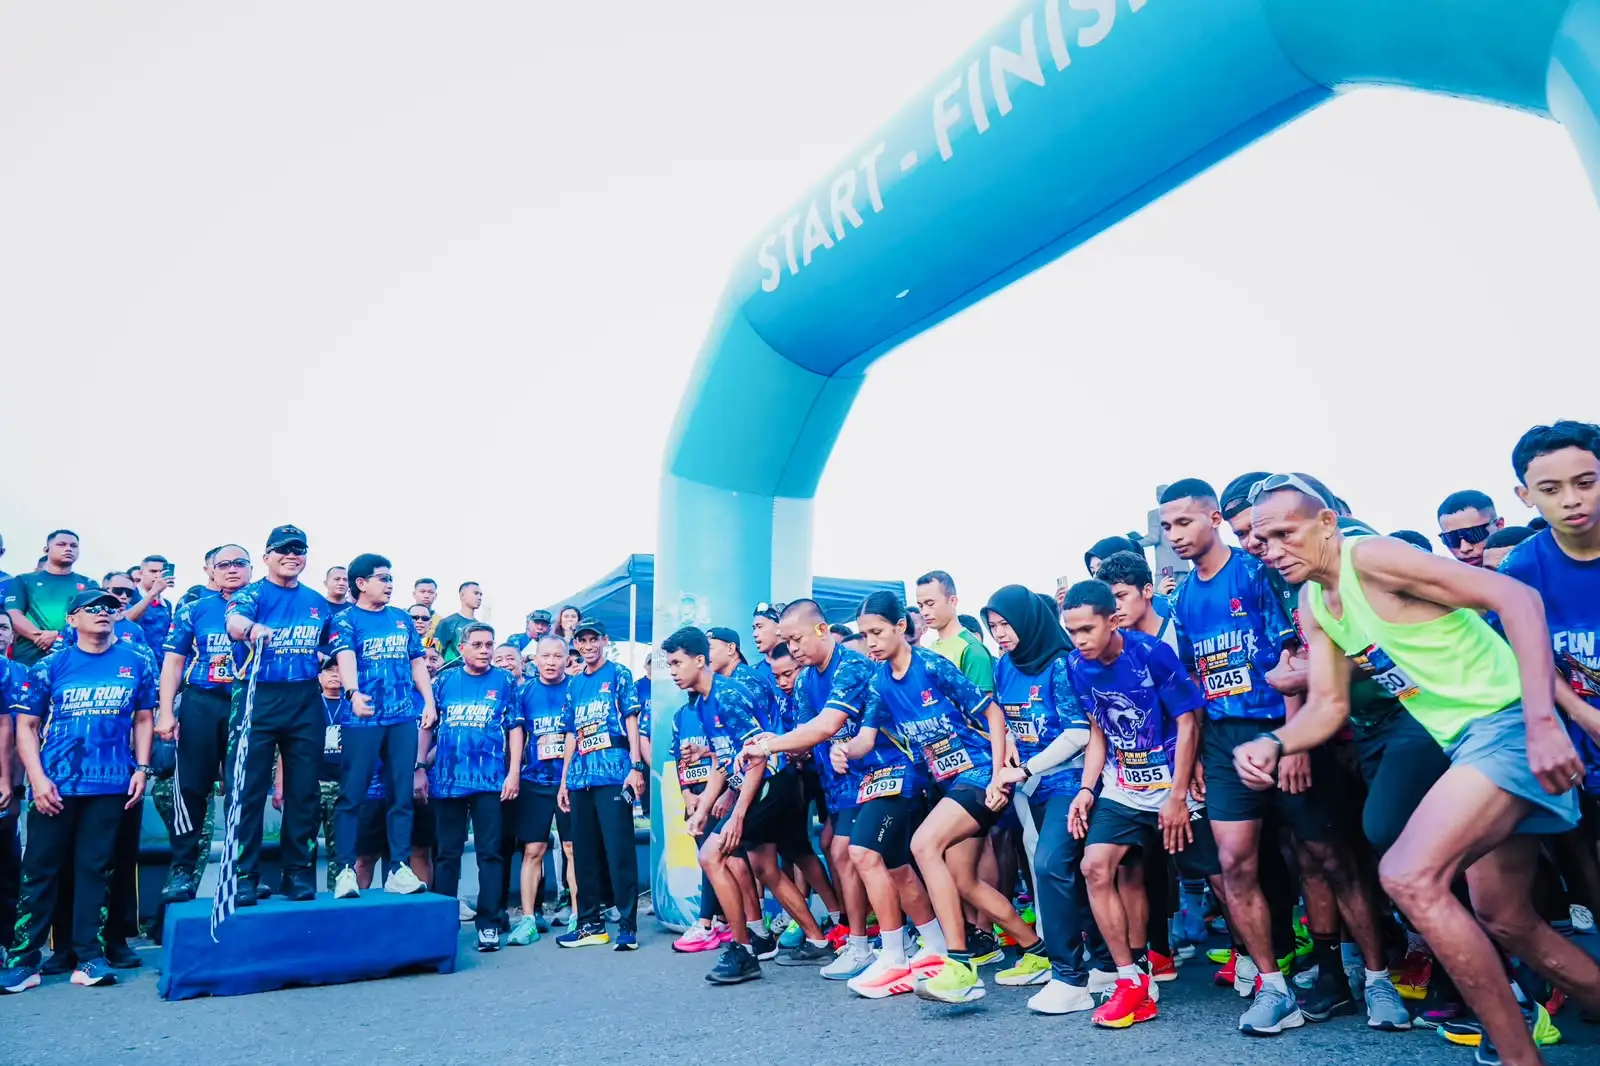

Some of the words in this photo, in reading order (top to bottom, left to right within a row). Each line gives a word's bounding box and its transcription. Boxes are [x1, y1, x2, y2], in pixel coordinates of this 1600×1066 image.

[757, 142, 885, 292] START
[932, 0, 1149, 162] FINIS
[293, 625, 318, 640] RUN
[363, 637, 384, 651] FUN
[385, 634, 407, 647] RUN
[1208, 671, 1243, 691] 0245
[63, 687, 93, 704] FUN
[93, 685, 126, 701] RUN
[1012, 722, 1030, 735] 567
[545, 743, 564, 754] 014
[582, 736, 605, 749] 0926
[937, 752, 967, 771] 0452
[686, 767, 708, 779] 0859
[1125, 768, 1163, 783] 0855
[866, 780, 897, 795] 0799
